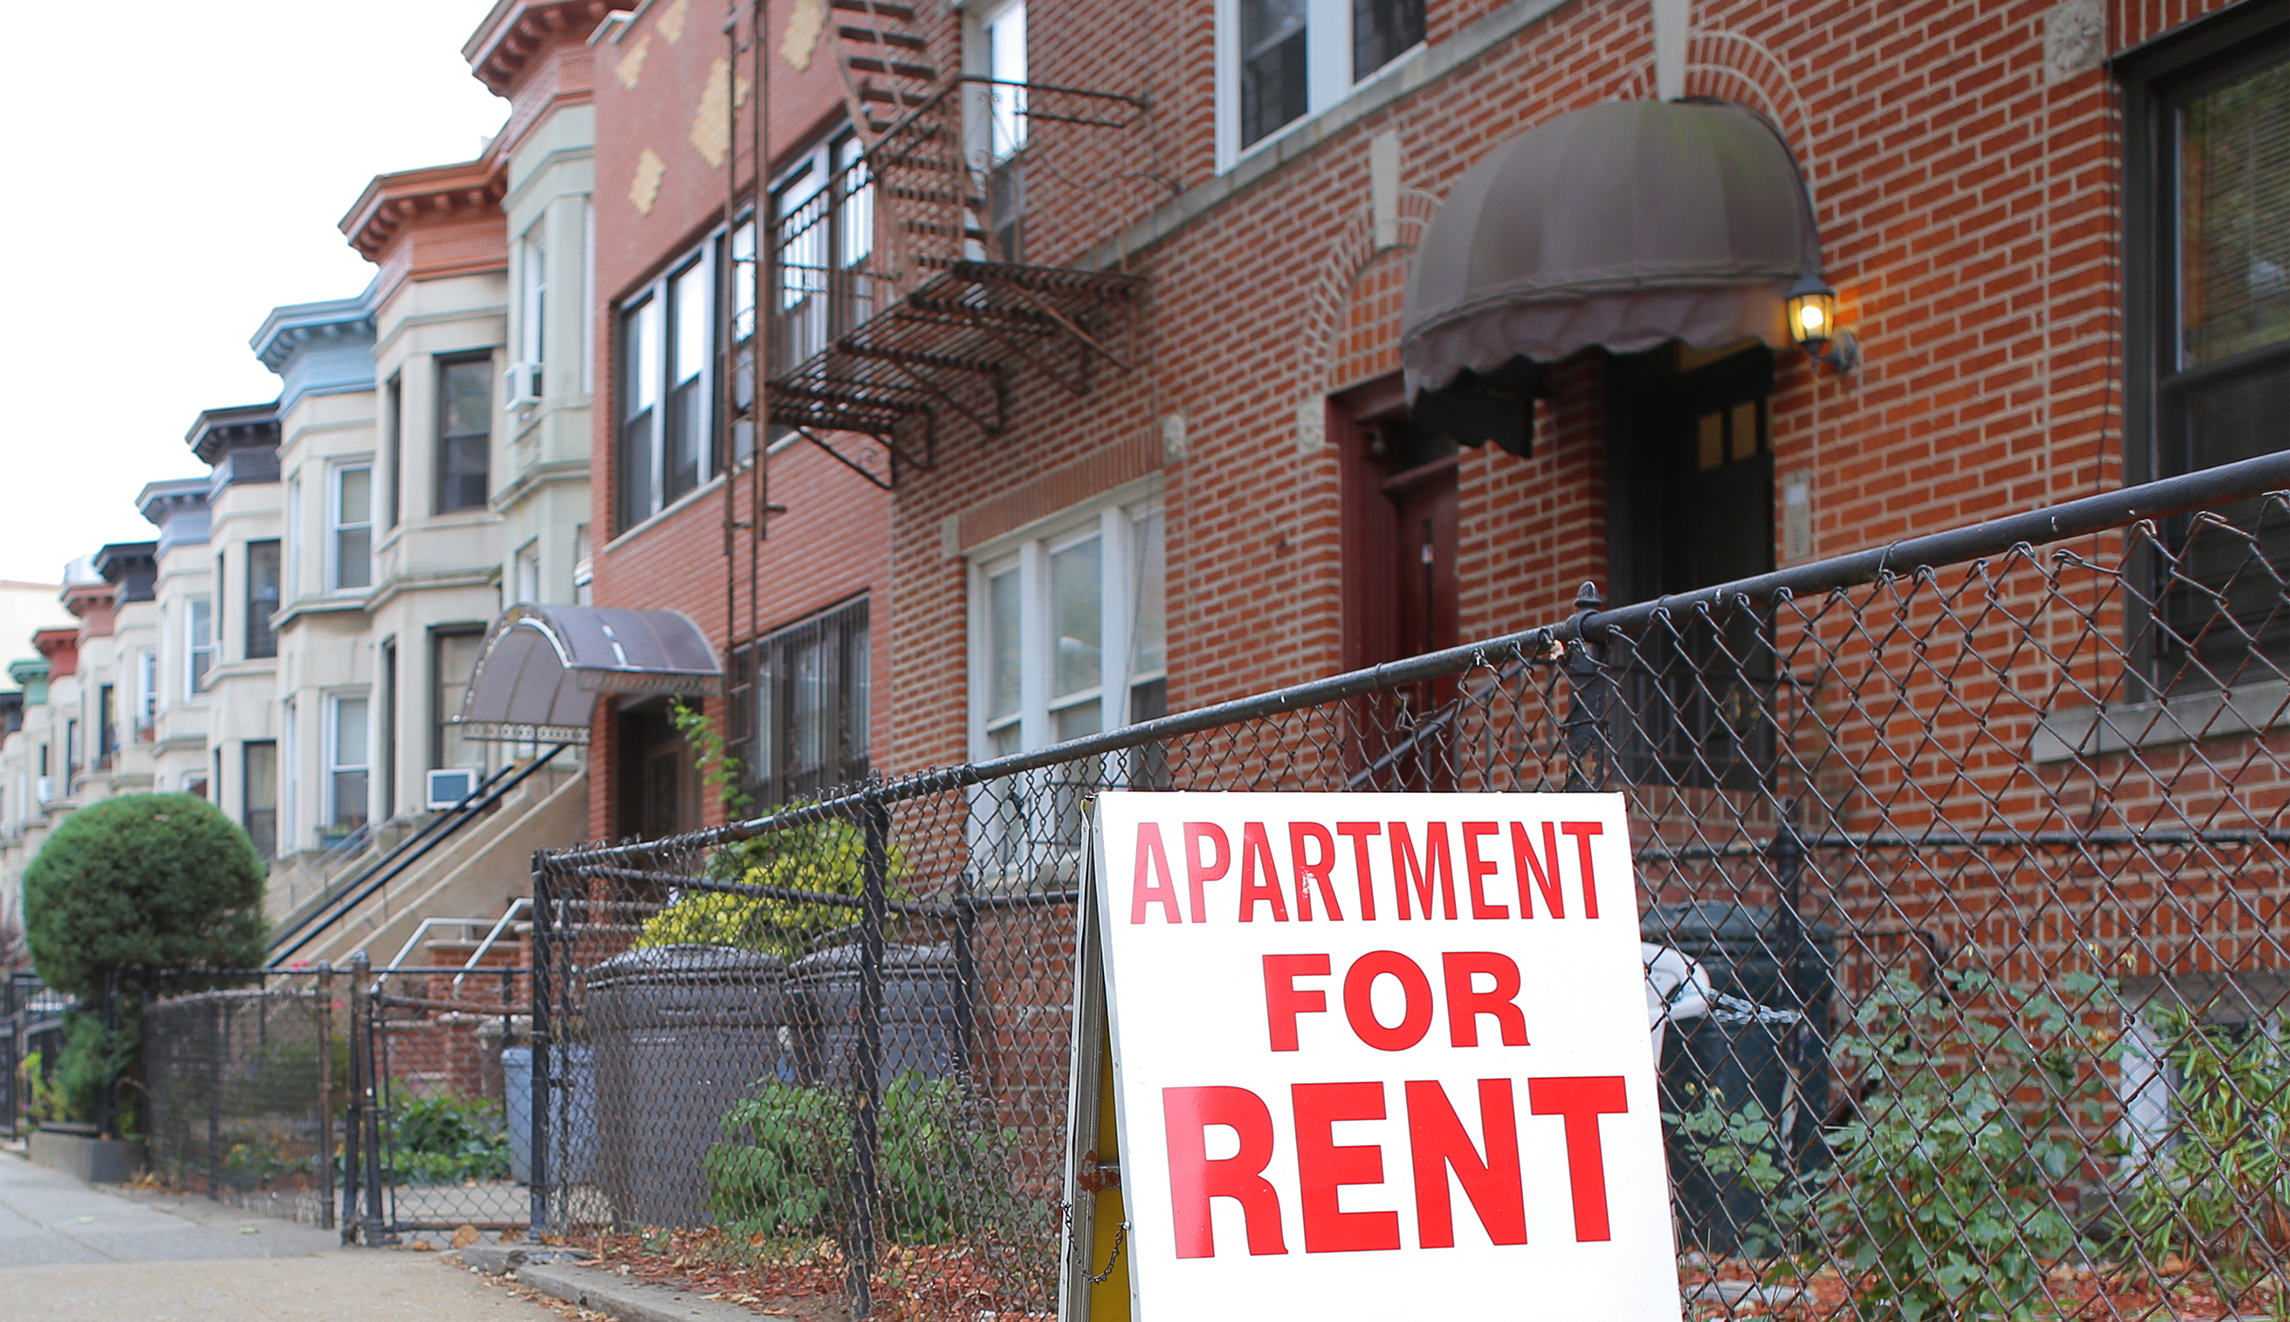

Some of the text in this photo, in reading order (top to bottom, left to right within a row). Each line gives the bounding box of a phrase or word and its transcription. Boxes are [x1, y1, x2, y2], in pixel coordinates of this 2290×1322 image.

[1131, 821, 1604, 925] APARTMENT
[1262, 950, 1531, 1052] FOR
[1162, 1075, 1629, 1259] RENT
